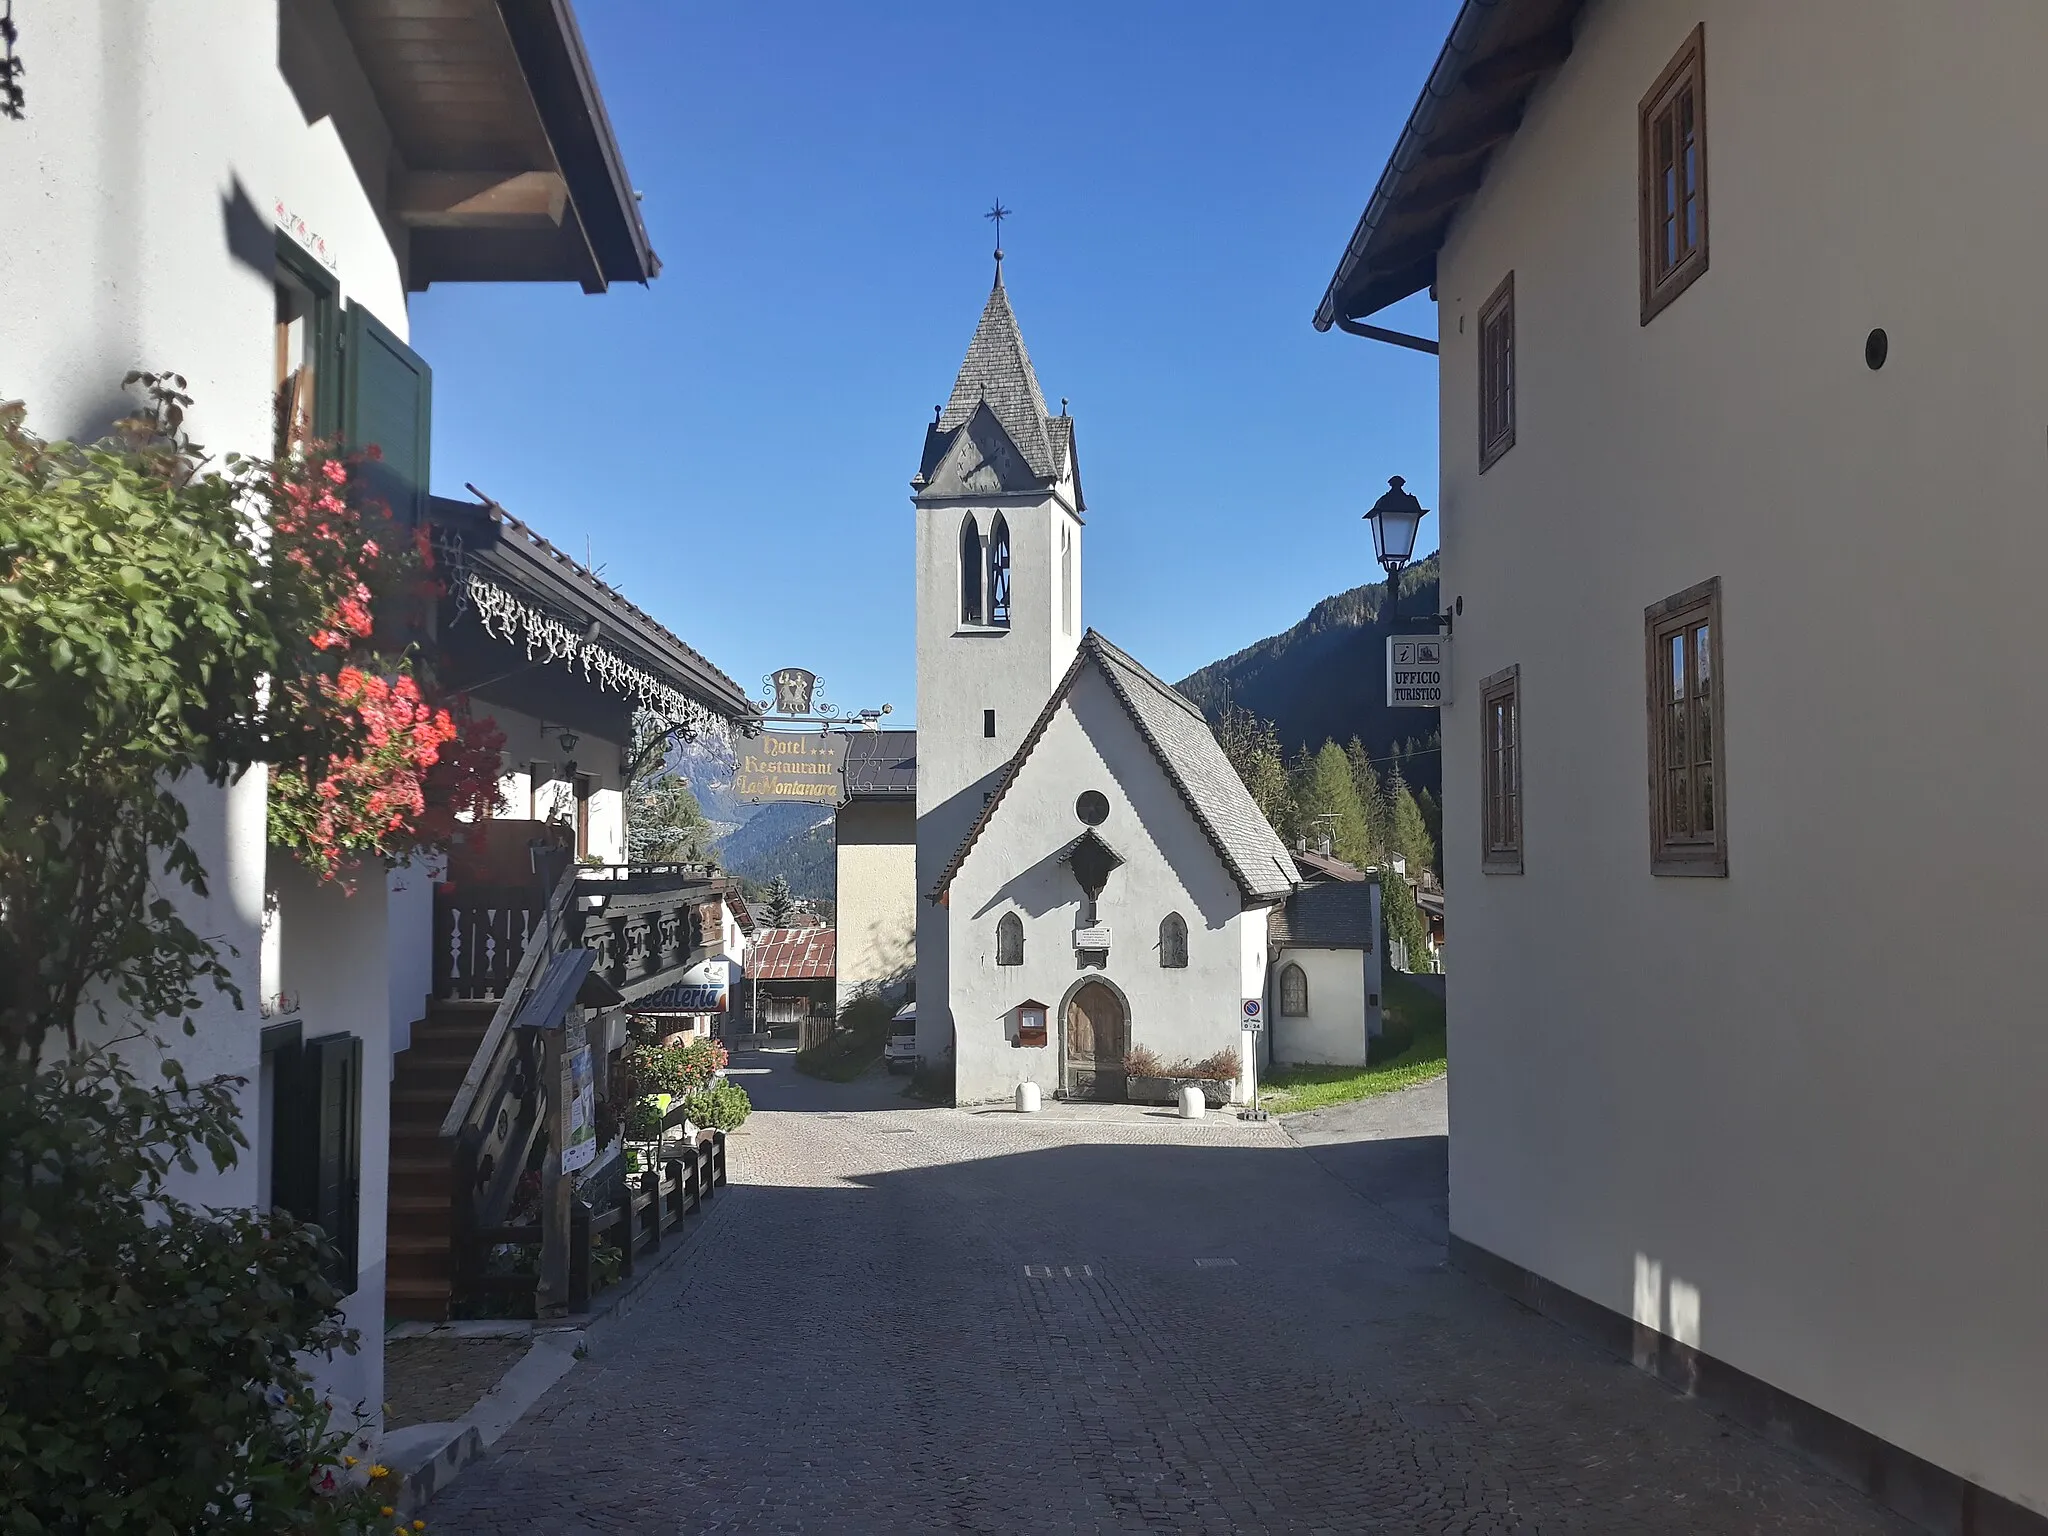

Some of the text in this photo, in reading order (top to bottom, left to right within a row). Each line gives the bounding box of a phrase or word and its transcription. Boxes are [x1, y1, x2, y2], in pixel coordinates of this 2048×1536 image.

[1395, 671, 1440, 684] UFFICIO
[1395, 687, 1441, 701] TURISTICO
[763, 735, 807, 757] Hotel
[744, 755, 833, 775] Restaurant
[757, 776, 838, 797] Montanara
